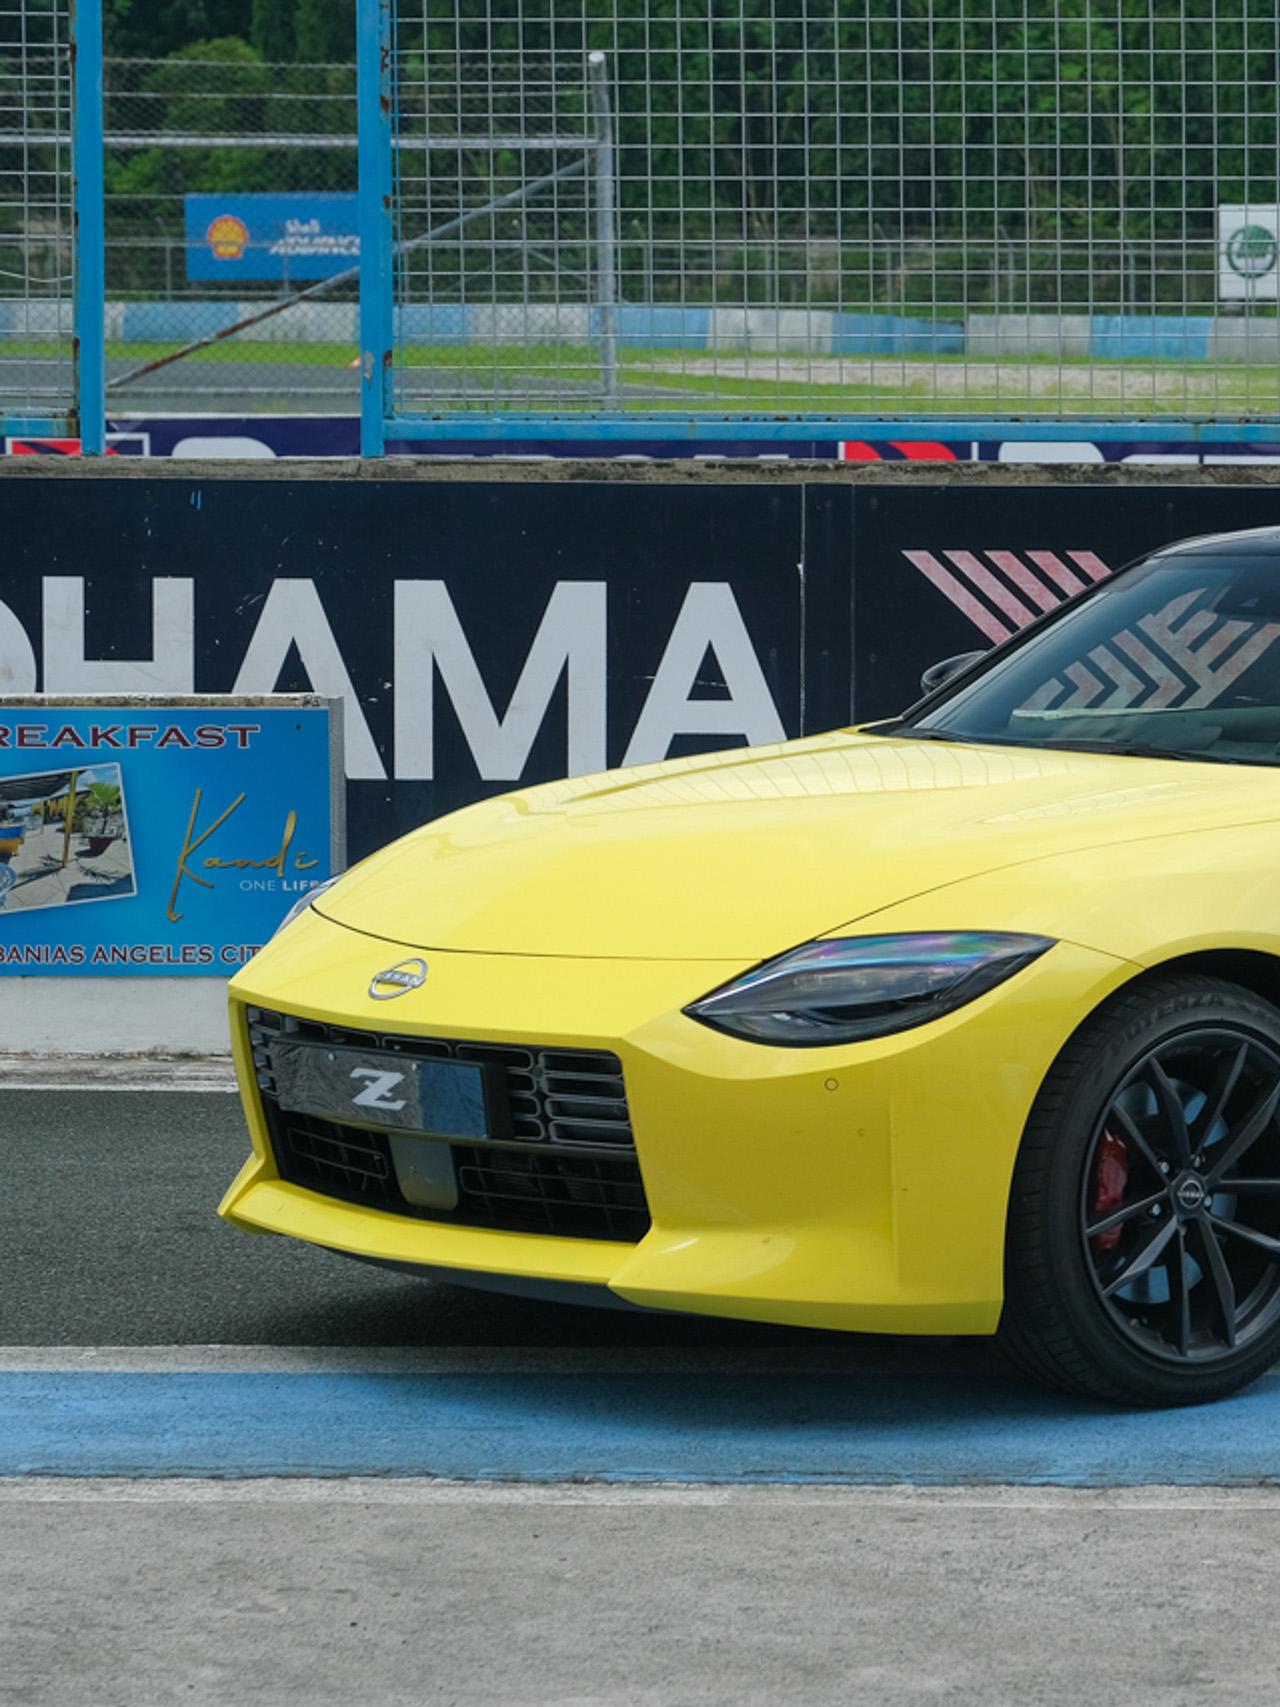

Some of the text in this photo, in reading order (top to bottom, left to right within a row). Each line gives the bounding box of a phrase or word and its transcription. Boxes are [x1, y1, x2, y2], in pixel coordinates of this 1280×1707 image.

[0, 576, 788, 781] HAMA
[240, 880, 276, 891] ONE
[92, 944, 214, 965] ANGELES
[350, 1067, 407, 1110] Z
